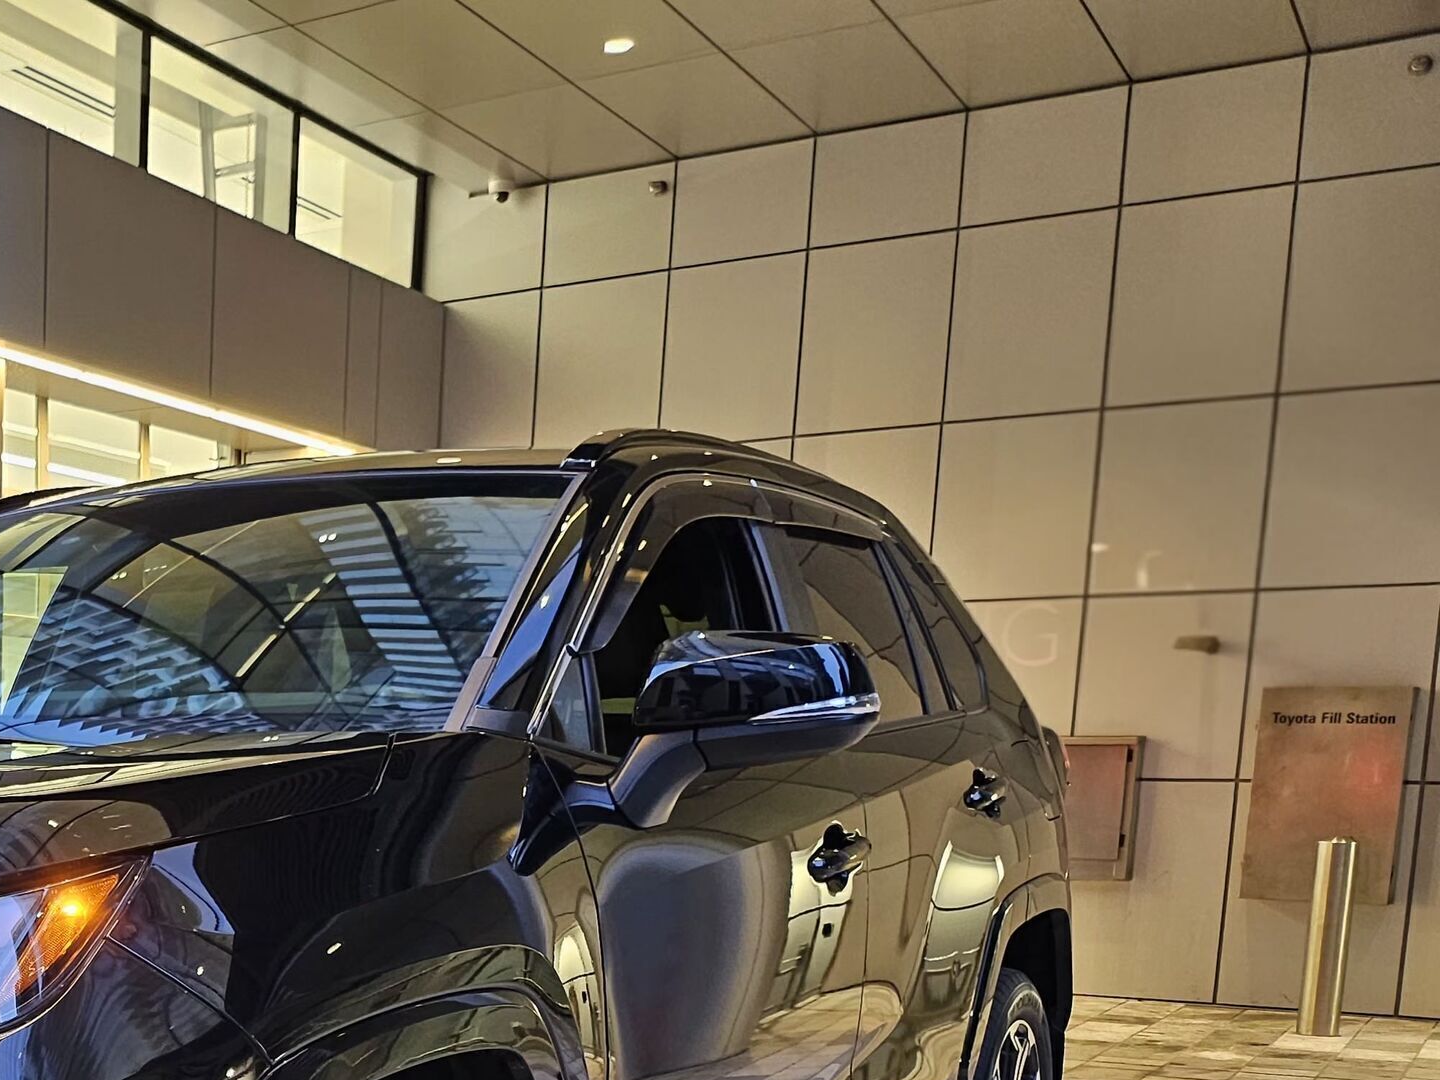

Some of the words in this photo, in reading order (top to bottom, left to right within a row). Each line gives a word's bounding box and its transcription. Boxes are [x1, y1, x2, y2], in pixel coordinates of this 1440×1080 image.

[1273, 712, 1316, 726] Toyota
[1321, 712, 1342, 724] Fill
[1346, 712, 1396, 724] Station
